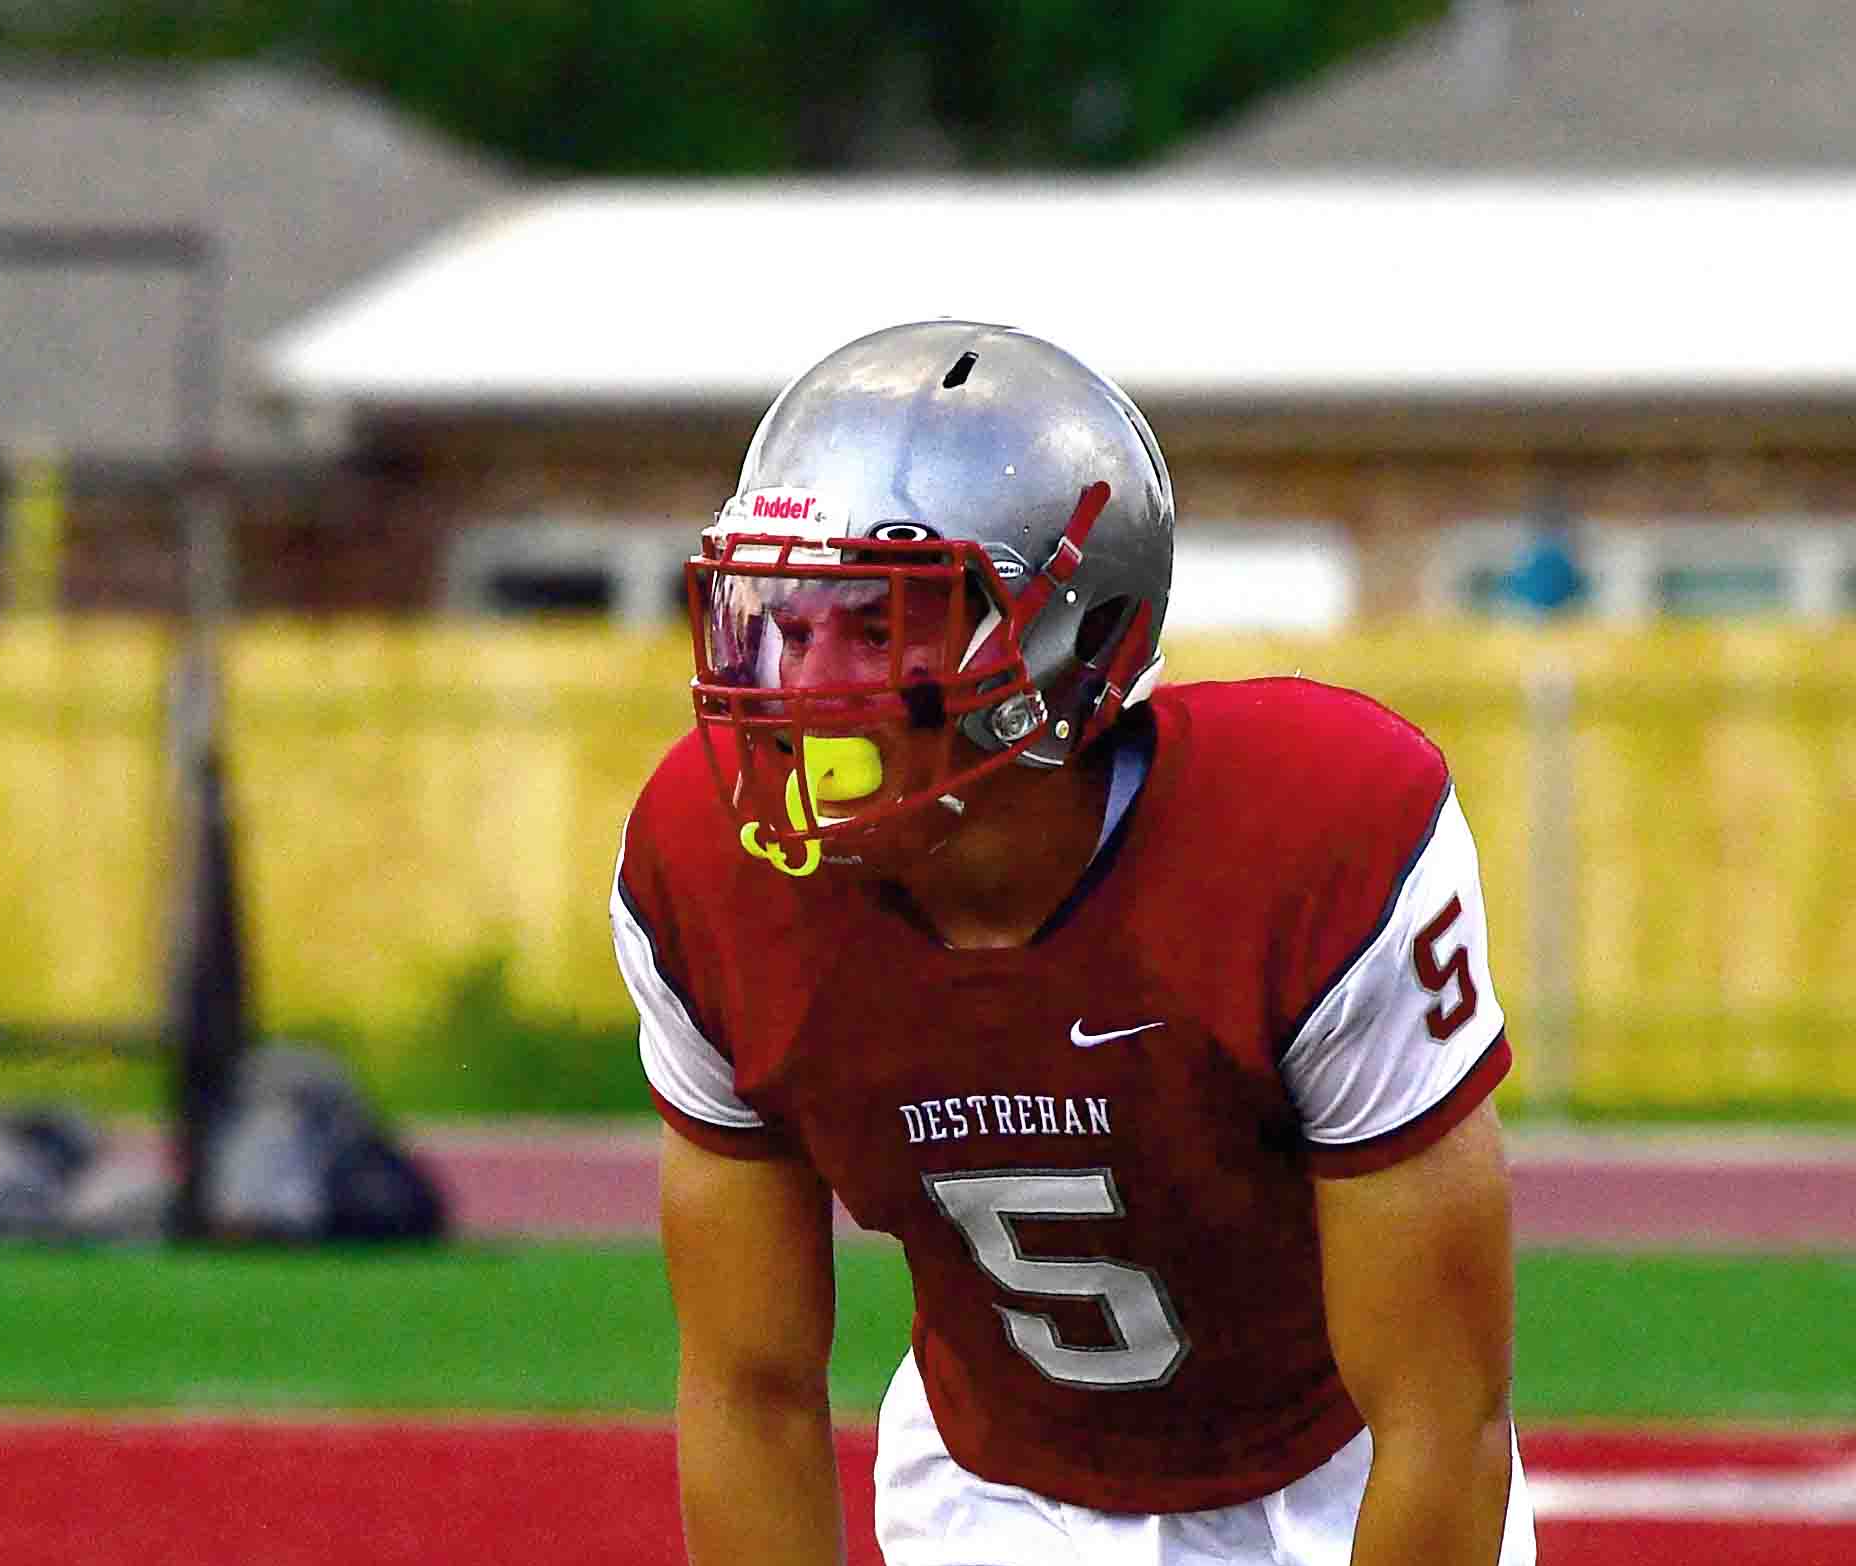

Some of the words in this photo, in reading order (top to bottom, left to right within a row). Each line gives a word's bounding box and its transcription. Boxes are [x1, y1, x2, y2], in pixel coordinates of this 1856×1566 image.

[1410, 889, 1478, 1045] 5
[900, 1095, 1112, 1144] DESTREHAN
[920, 1167, 1191, 1391] 5
